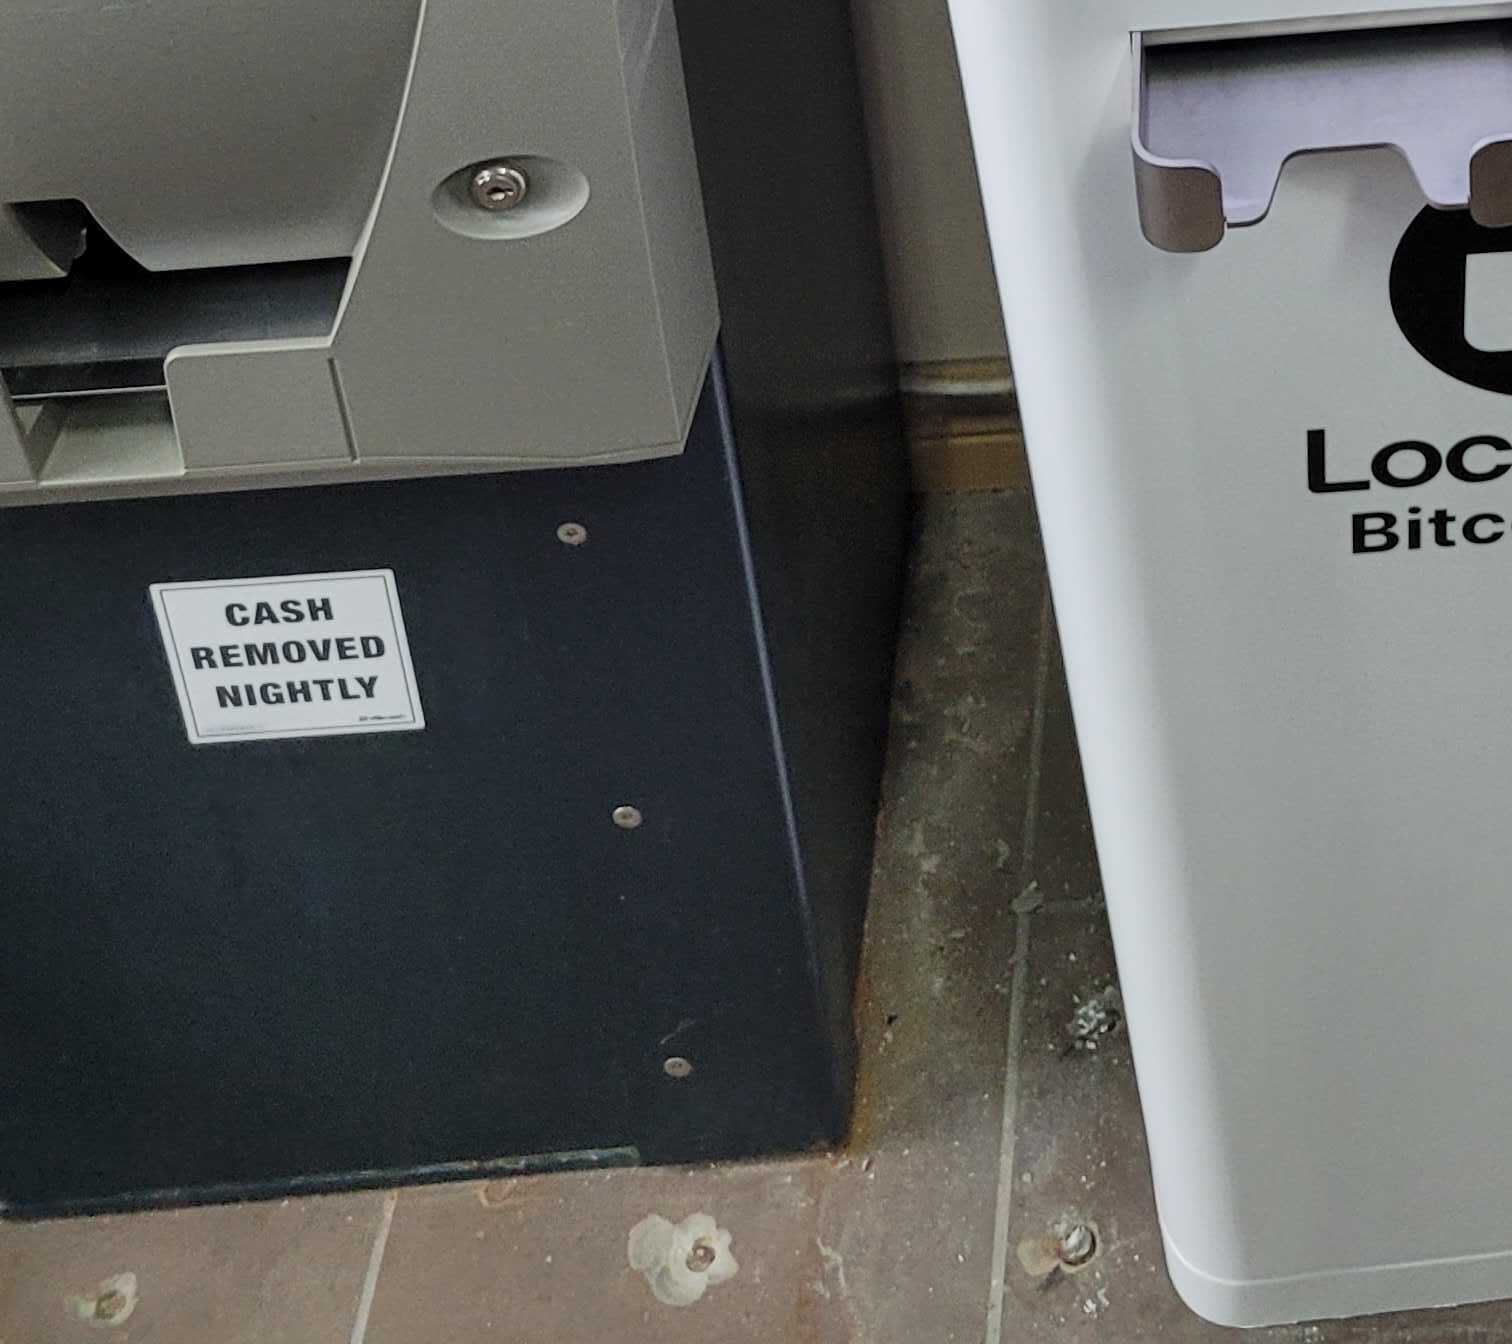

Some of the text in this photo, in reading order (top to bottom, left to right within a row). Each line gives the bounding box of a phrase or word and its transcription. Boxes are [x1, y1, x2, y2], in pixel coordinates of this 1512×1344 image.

[225, 598, 334, 627] CASH
[190, 636, 385, 670] REMOVED
[215, 675, 379, 709] NIGHTLY
